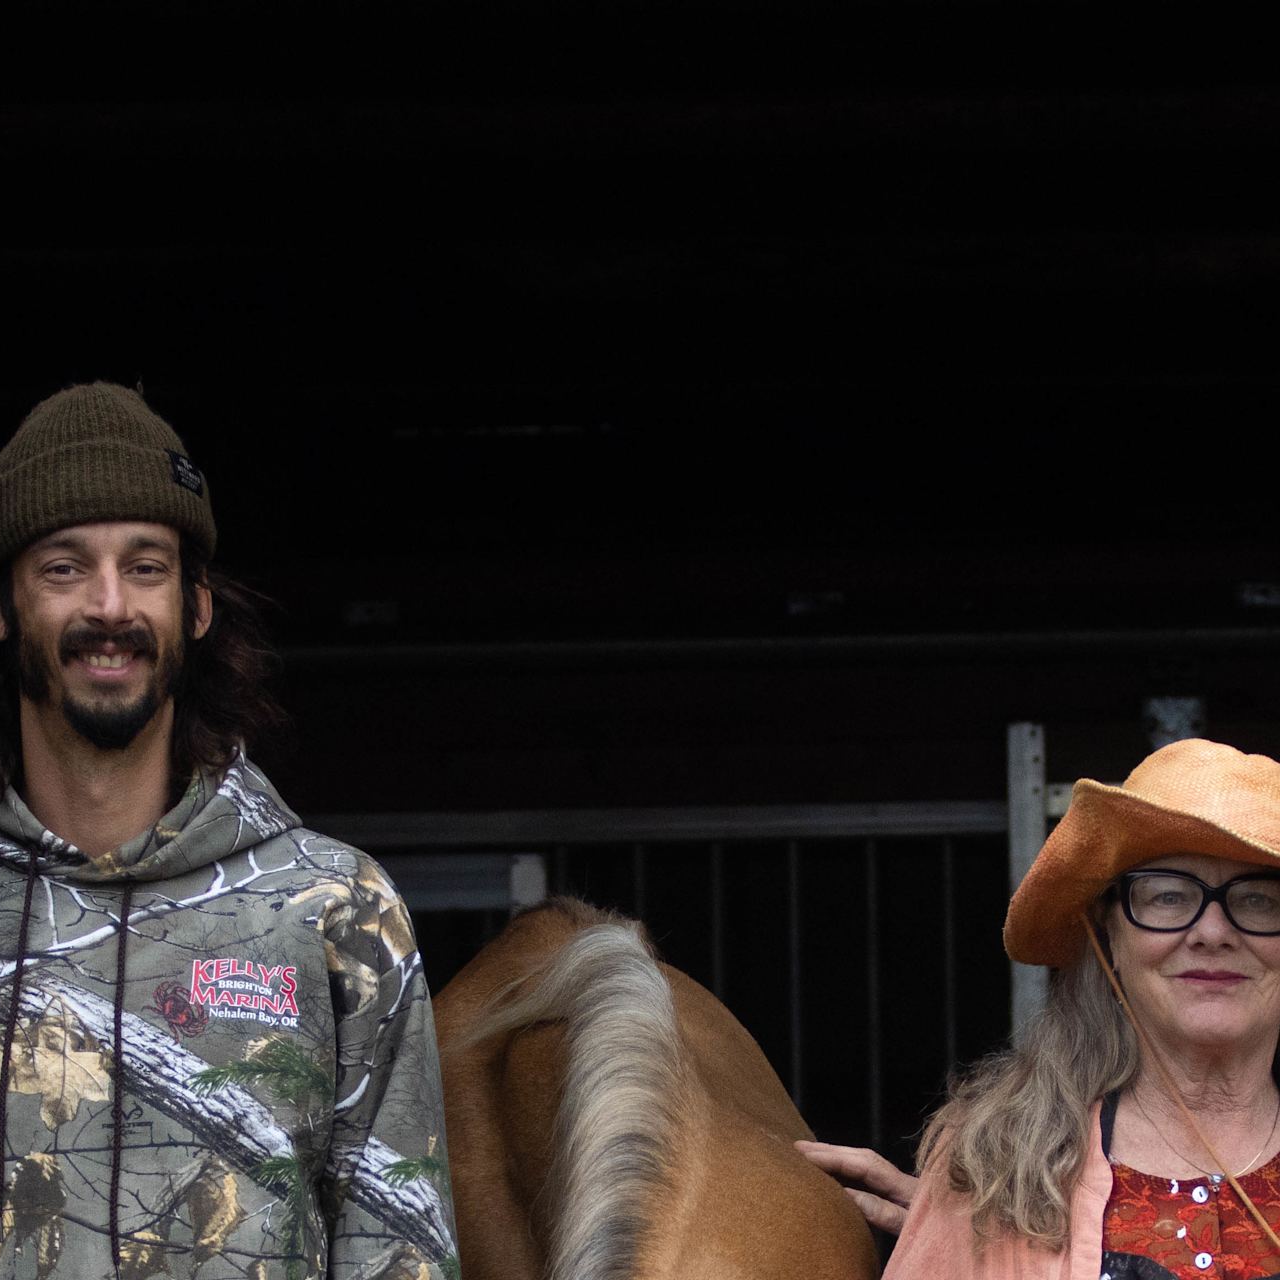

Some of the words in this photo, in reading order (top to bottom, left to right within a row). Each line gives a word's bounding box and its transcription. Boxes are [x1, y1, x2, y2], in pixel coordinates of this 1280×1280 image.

[191, 959, 297, 995] KELLY'S
[218, 979, 273, 996] BRIGHTON
[189, 984, 300, 1016] MARINA
[208, 1007, 258, 1020] Nehalem
[258, 1013, 279, 1028] Bay,
[281, 1016, 299, 1028] OR
